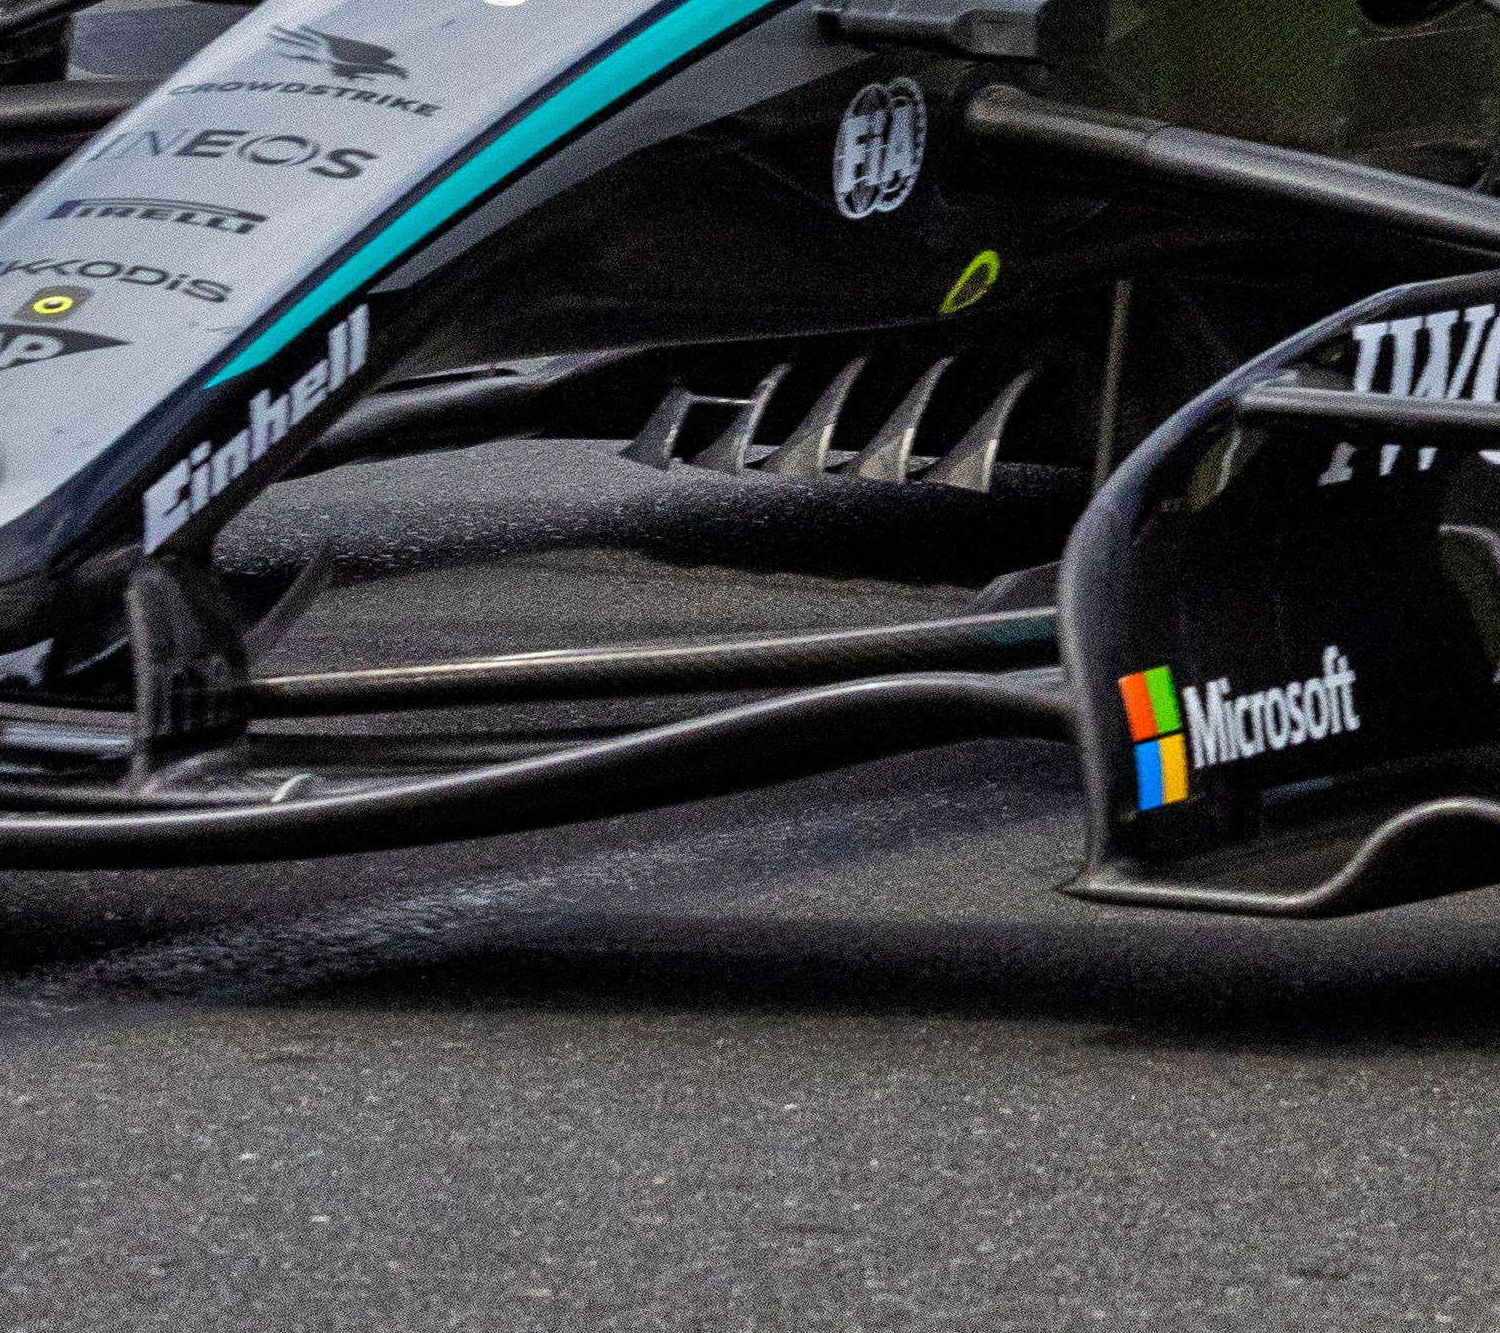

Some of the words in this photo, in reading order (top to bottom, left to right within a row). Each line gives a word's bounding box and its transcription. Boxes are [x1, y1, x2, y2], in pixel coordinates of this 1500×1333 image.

[168, 79, 444, 118] CROWDSTRIKE
[87, 129, 380, 182] INEOS
[45, 197, 269, 236] PIRELLI
[142, 303, 371, 555] Einhell
[1181, 644, 1360, 770] Microsoft
